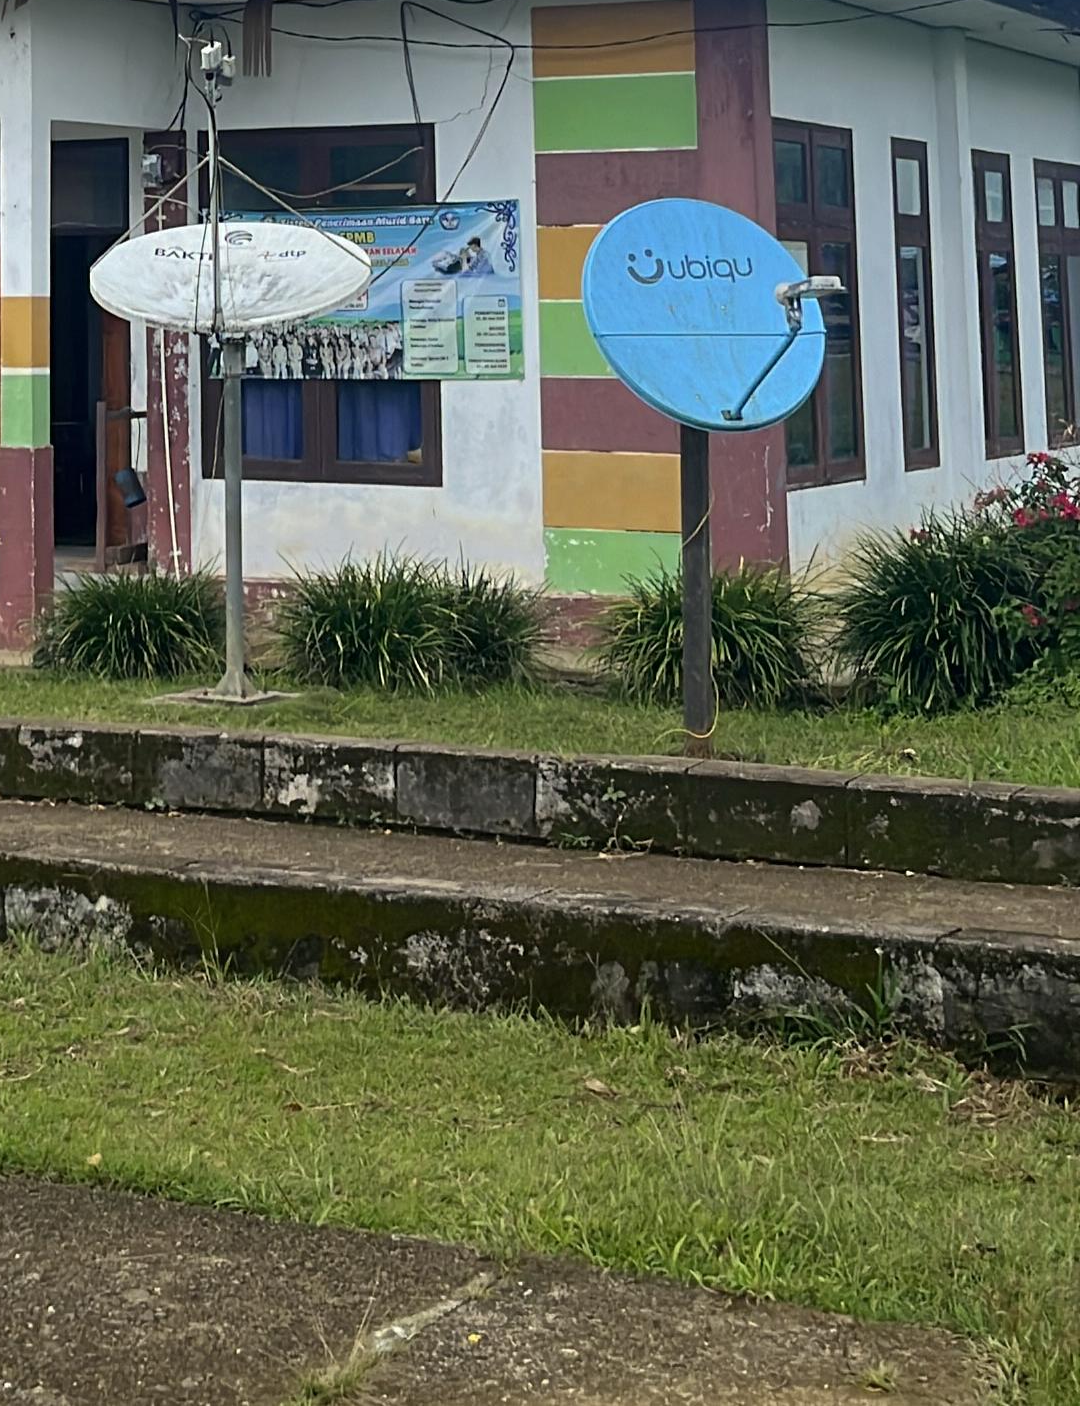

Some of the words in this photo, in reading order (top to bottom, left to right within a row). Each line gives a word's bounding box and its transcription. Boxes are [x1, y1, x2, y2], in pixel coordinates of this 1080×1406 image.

[375, 216, 407, 226] Murid
[155, 247, 213, 261] BAKTI
[667, 254, 753, 283] ubiqu
